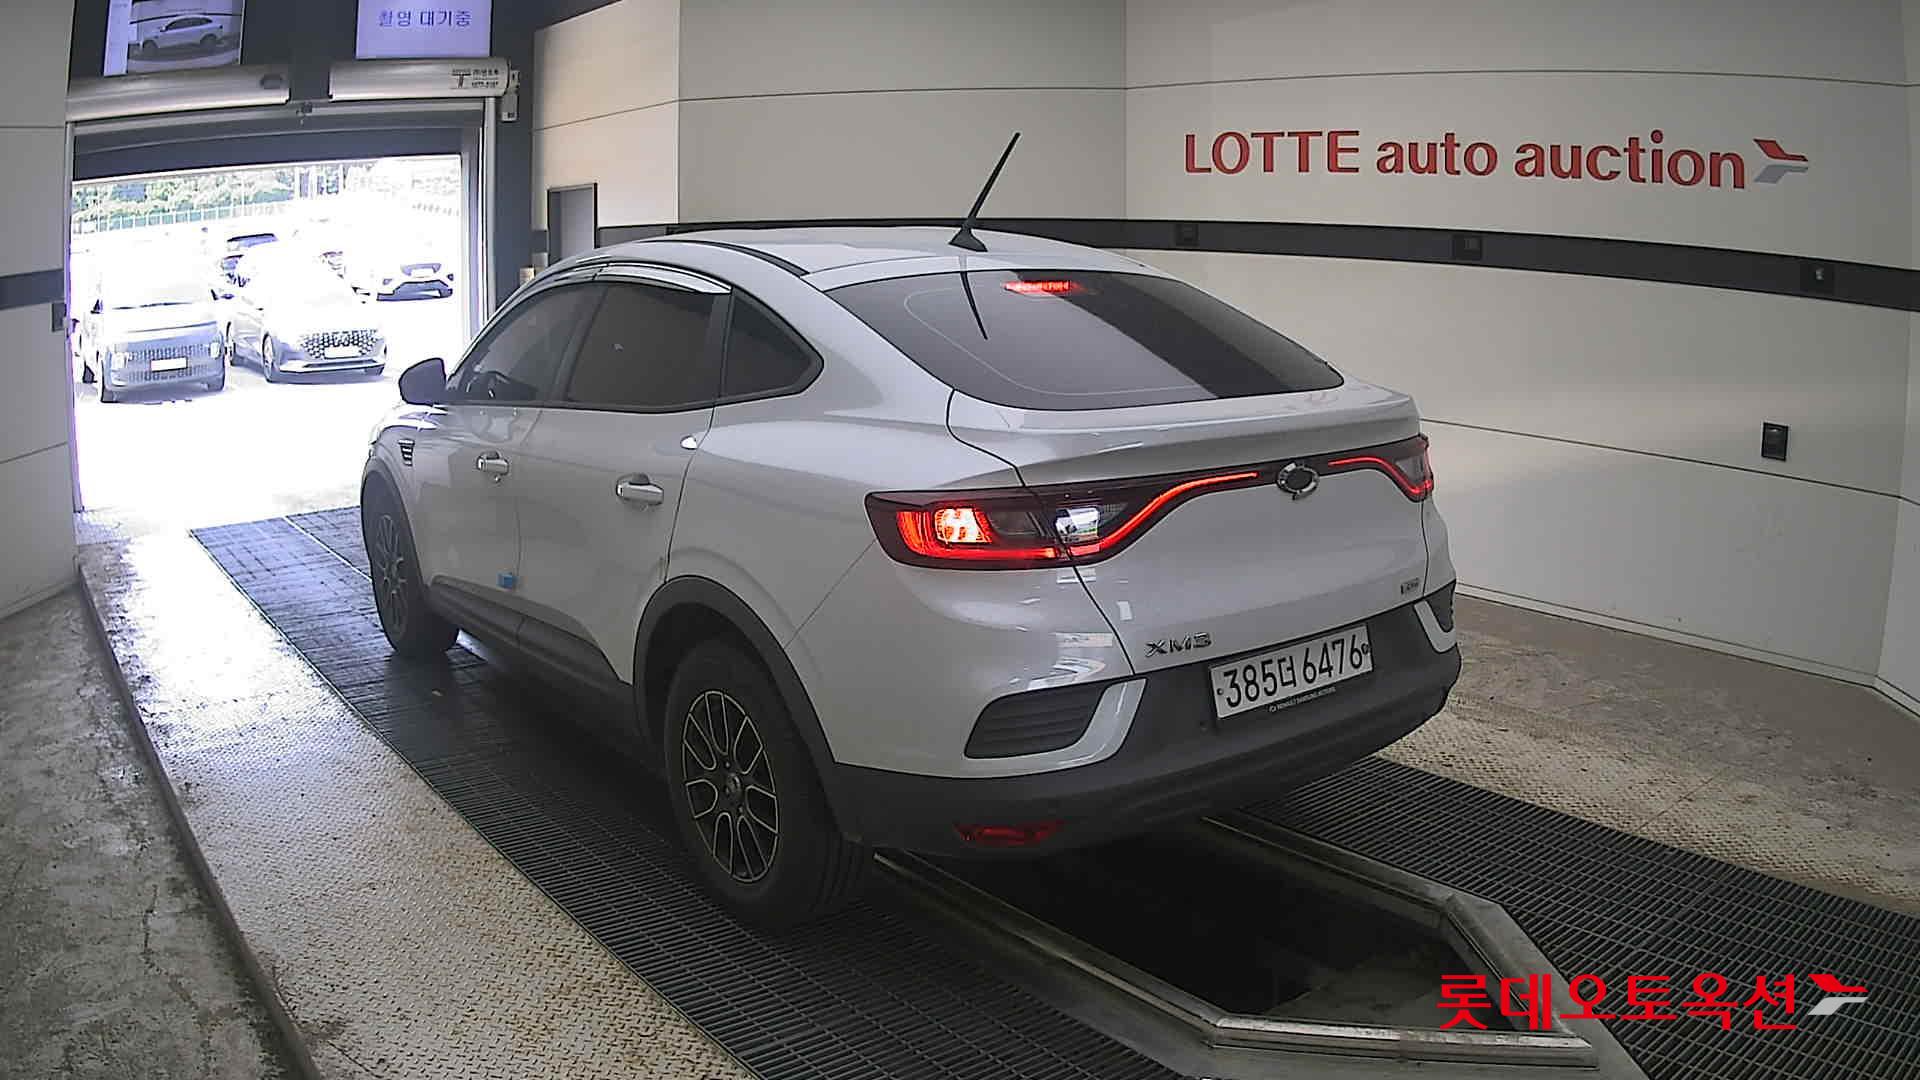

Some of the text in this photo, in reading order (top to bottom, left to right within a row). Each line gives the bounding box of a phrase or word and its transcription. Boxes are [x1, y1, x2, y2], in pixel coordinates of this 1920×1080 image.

[420, 10, 471, 26] 대기중
[1186, 131, 1744, 188] LOTTE auto auction
[1145, 632, 1212, 657] XM3
[1223, 655, 1297, 708] 385더
[1303, 633, 1362, 684] 6476
